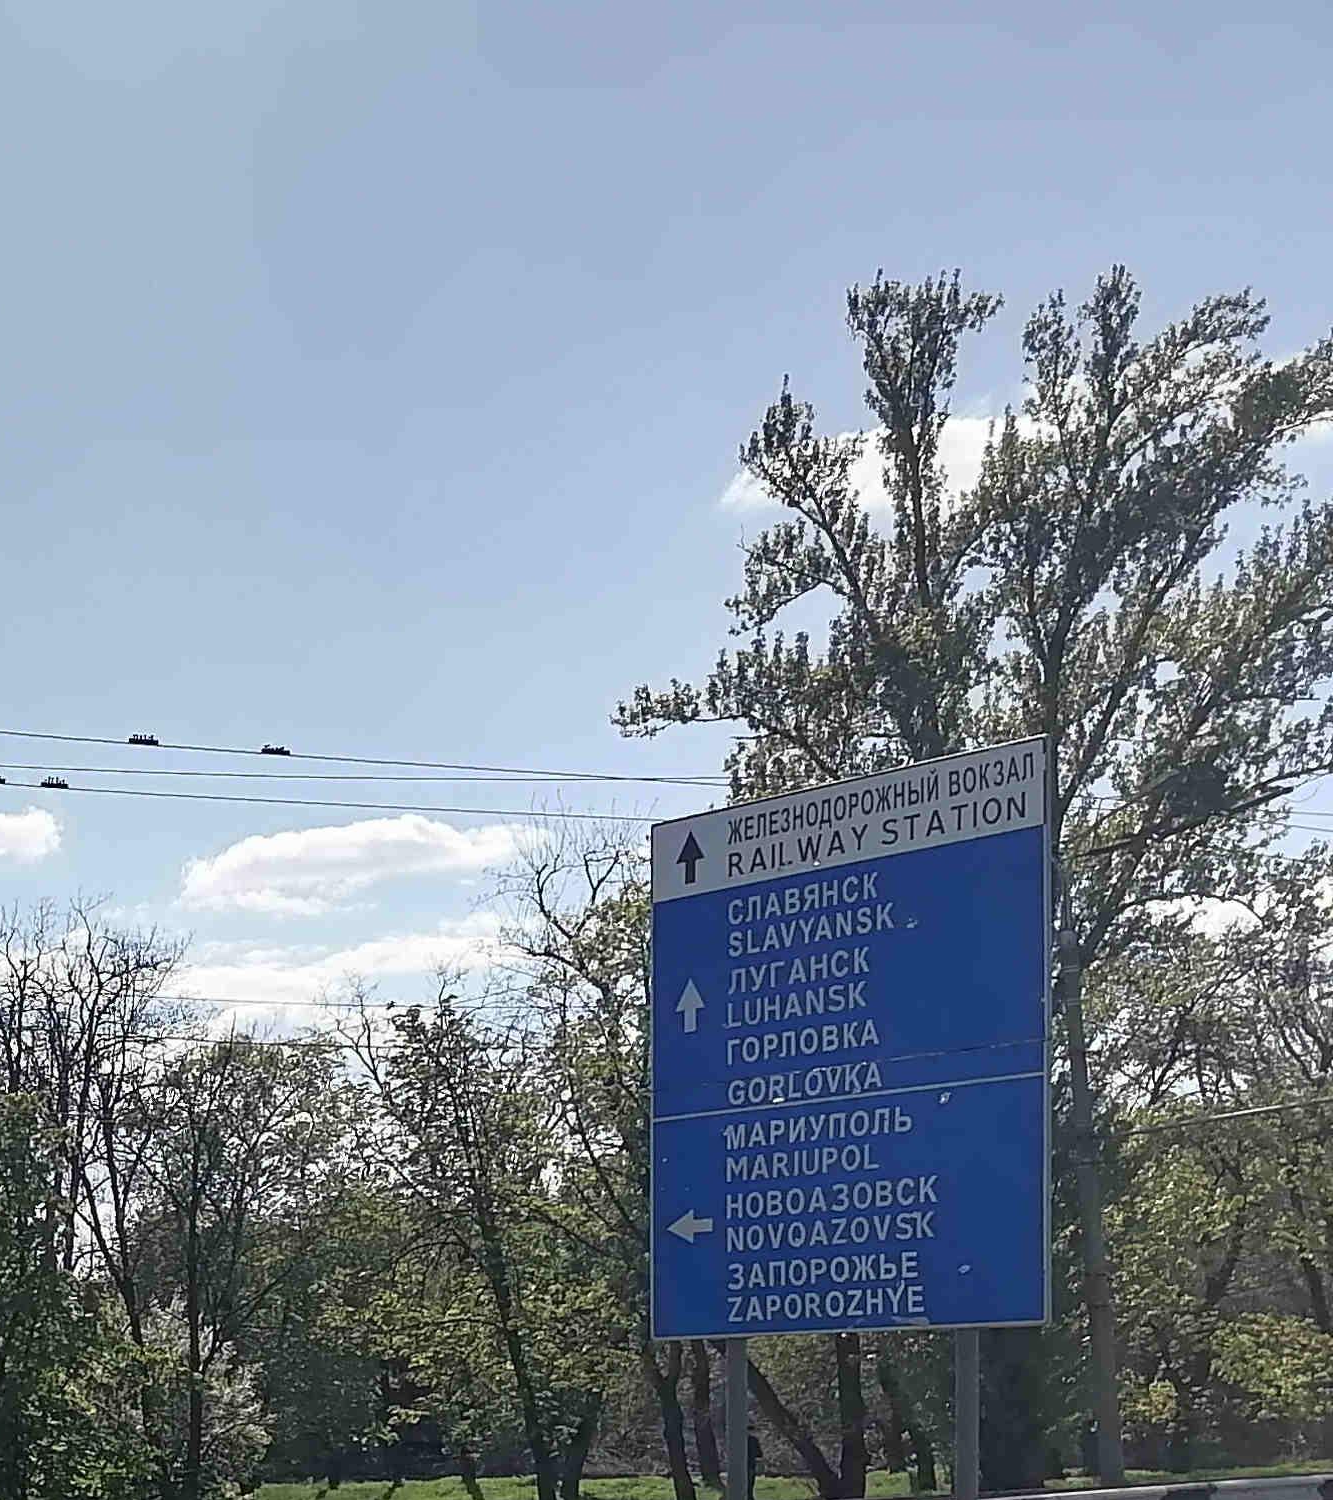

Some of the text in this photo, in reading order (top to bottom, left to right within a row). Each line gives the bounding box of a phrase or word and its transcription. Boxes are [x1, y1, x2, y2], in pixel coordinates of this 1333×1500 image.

[727, 751, 1034, 845] ЖЕЛЕЗНОДОРОЖНЫЙ ВОКЗАЛ
[728, 792, 1026, 877] RAILWAY STATION
[728, 871, 878, 925] СЛАВЯНСК
[729, 902, 895, 957] SLAVYANSK
[728, 946, 870, 995] ЛУГАНСК
[726, 980, 867, 1029] LUHANSK
[727, 1019, 880, 1066] ГОРЛОВКА
[728, 1062, 882, 1105] GORLOVKA
[725, 1106, 912, 1150] МАРИУПОЛЬ
[726, 1143, 880, 1183] MARIUPOL
[726, 1175, 938, 1219] НОВОАЗОВСК
[727, 1211, 935, 1252] NOVOAZOVSK
[728, 1251, 919, 1290] ЗАПОРОЖЬЕ
[728, 1284, 925, 1322] ZAPOROZHYE
